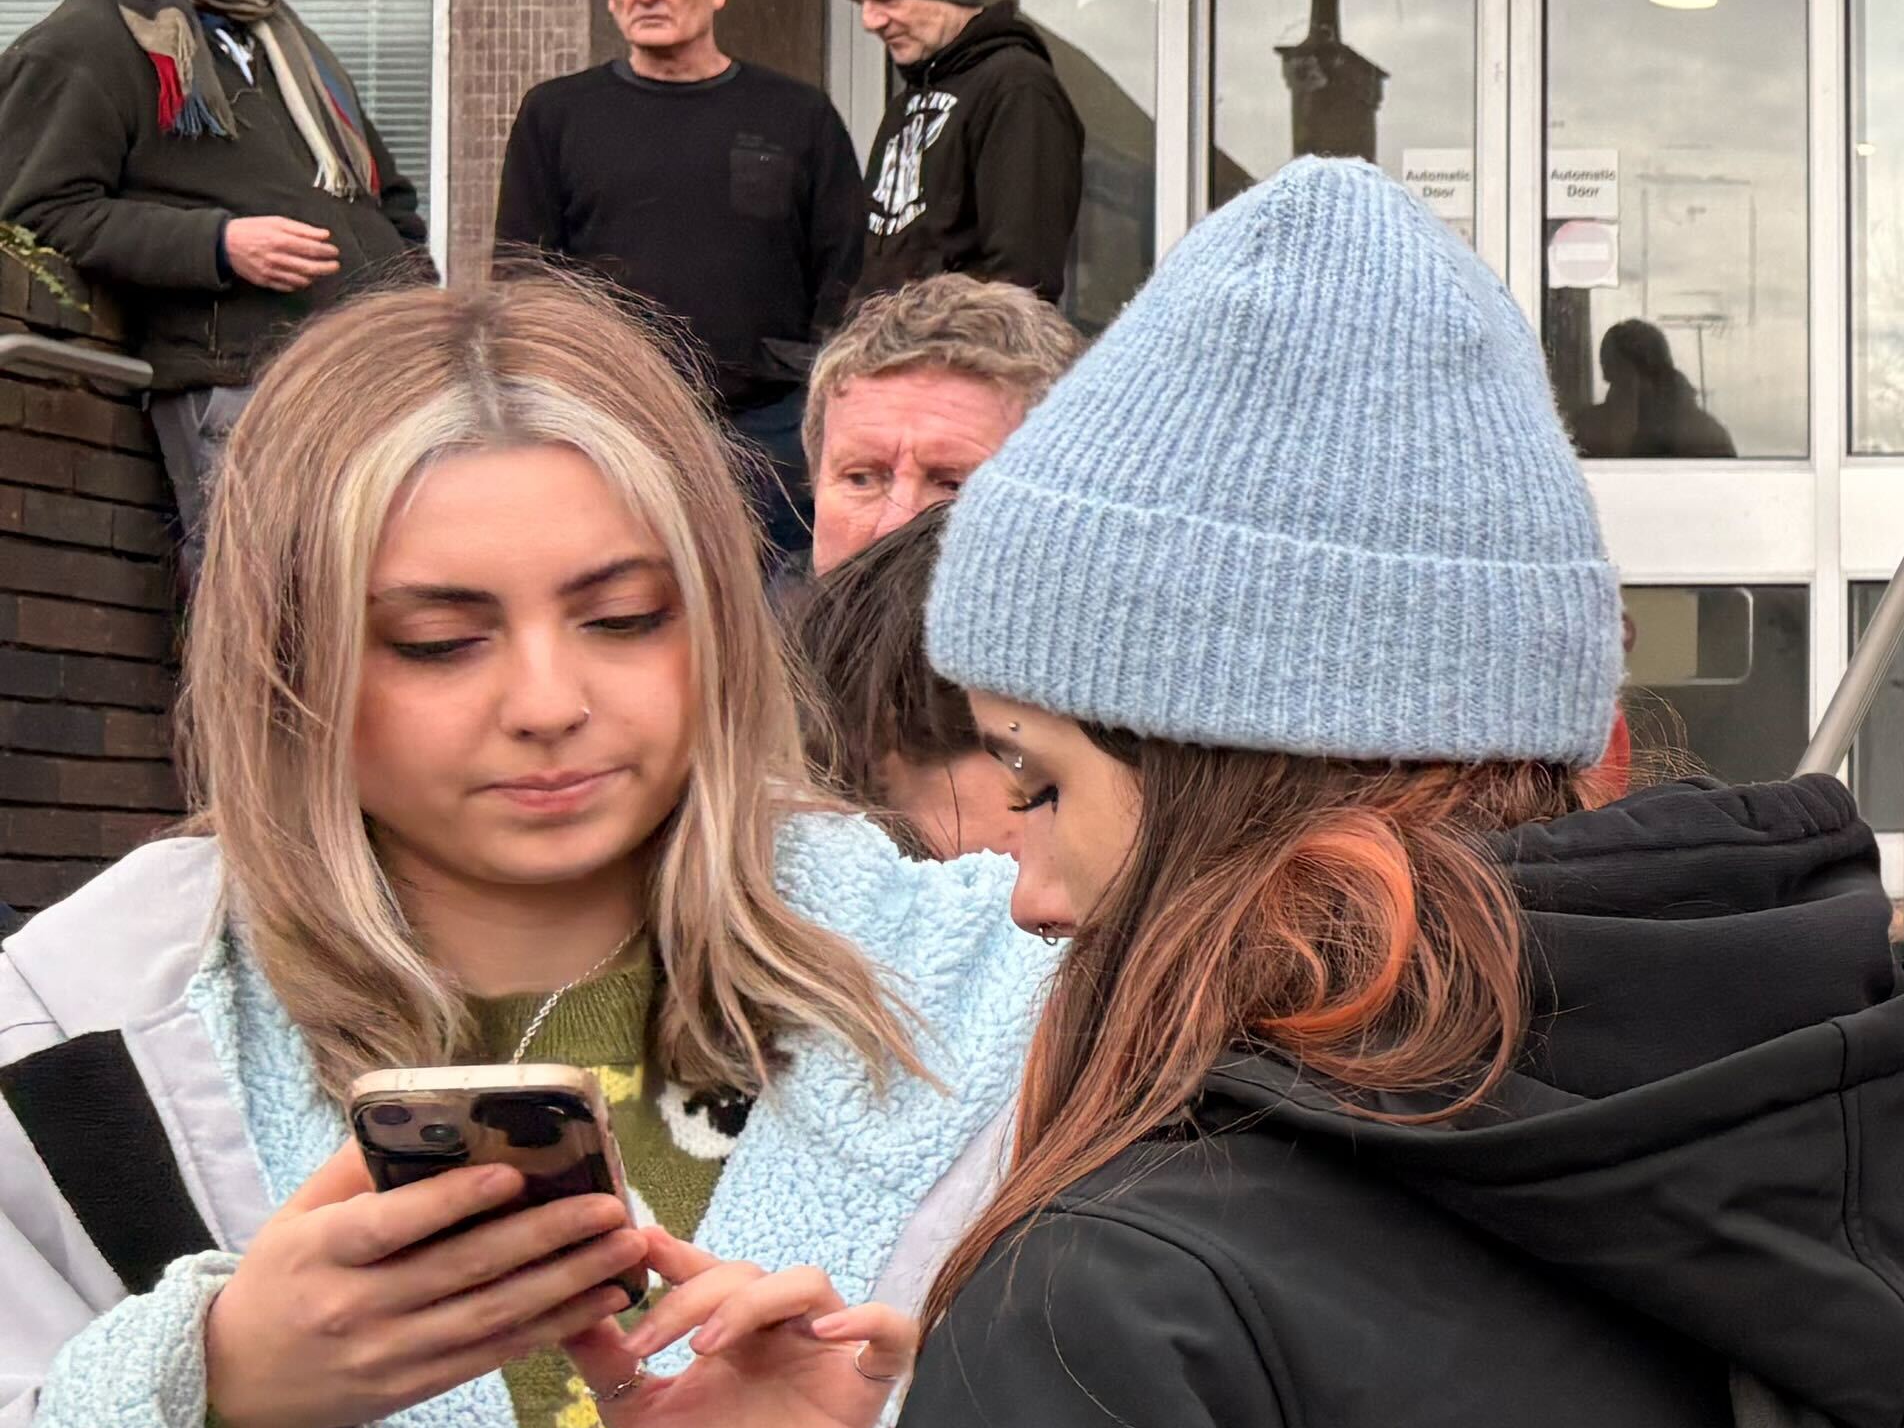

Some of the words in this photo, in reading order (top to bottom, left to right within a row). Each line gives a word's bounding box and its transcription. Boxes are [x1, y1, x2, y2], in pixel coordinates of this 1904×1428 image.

[1405, 169, 1472, 182] Automatic
[1550, 168, 1616, 181] Automatic
[1422, 186, 1456, 198] Door
[1566, 185, 1600, 198] Door
